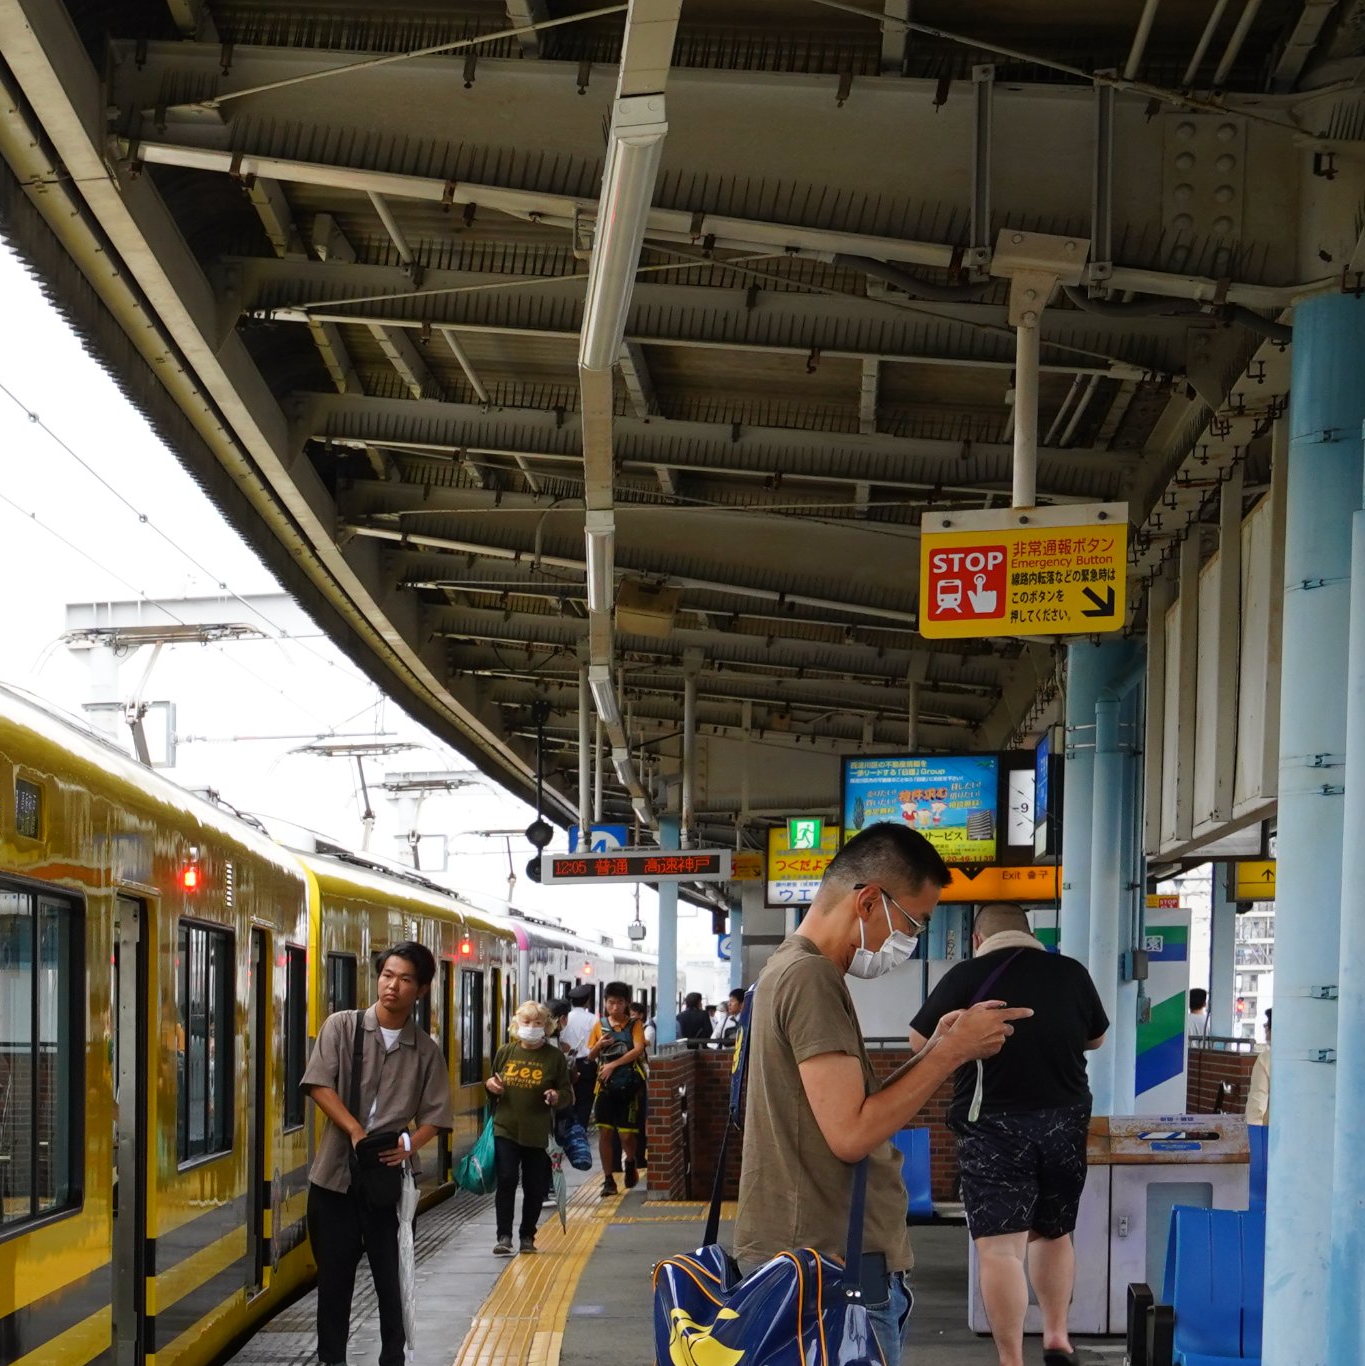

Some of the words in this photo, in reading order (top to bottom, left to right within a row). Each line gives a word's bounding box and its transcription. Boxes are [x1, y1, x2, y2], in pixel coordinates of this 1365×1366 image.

[1012, 537, 1115, 558] 非常通報ボタン
[932, 551, 1004, 574] STOP
[1011, 557, 1071, 569] Emergency
[1076, 555, 1113, 566] Button
[1011, 568, 1116, 587] 線路内転落などの緊急時は
[1011, 589, 1065, 604] このボタンを
[1010, 609, 1071, 624] 押してください。
[1020, 802, 1029, 814] 9
[555, 860, 588, 875] 12:05
[594, 858, 629, 875] 普通
[643, 855, 711, 874] 高速神戸
[1002, 870, 1021, 880] Exit
[1158, 898, 1178, 906] STOP
[504, 1063, 543, 1080] Lee
